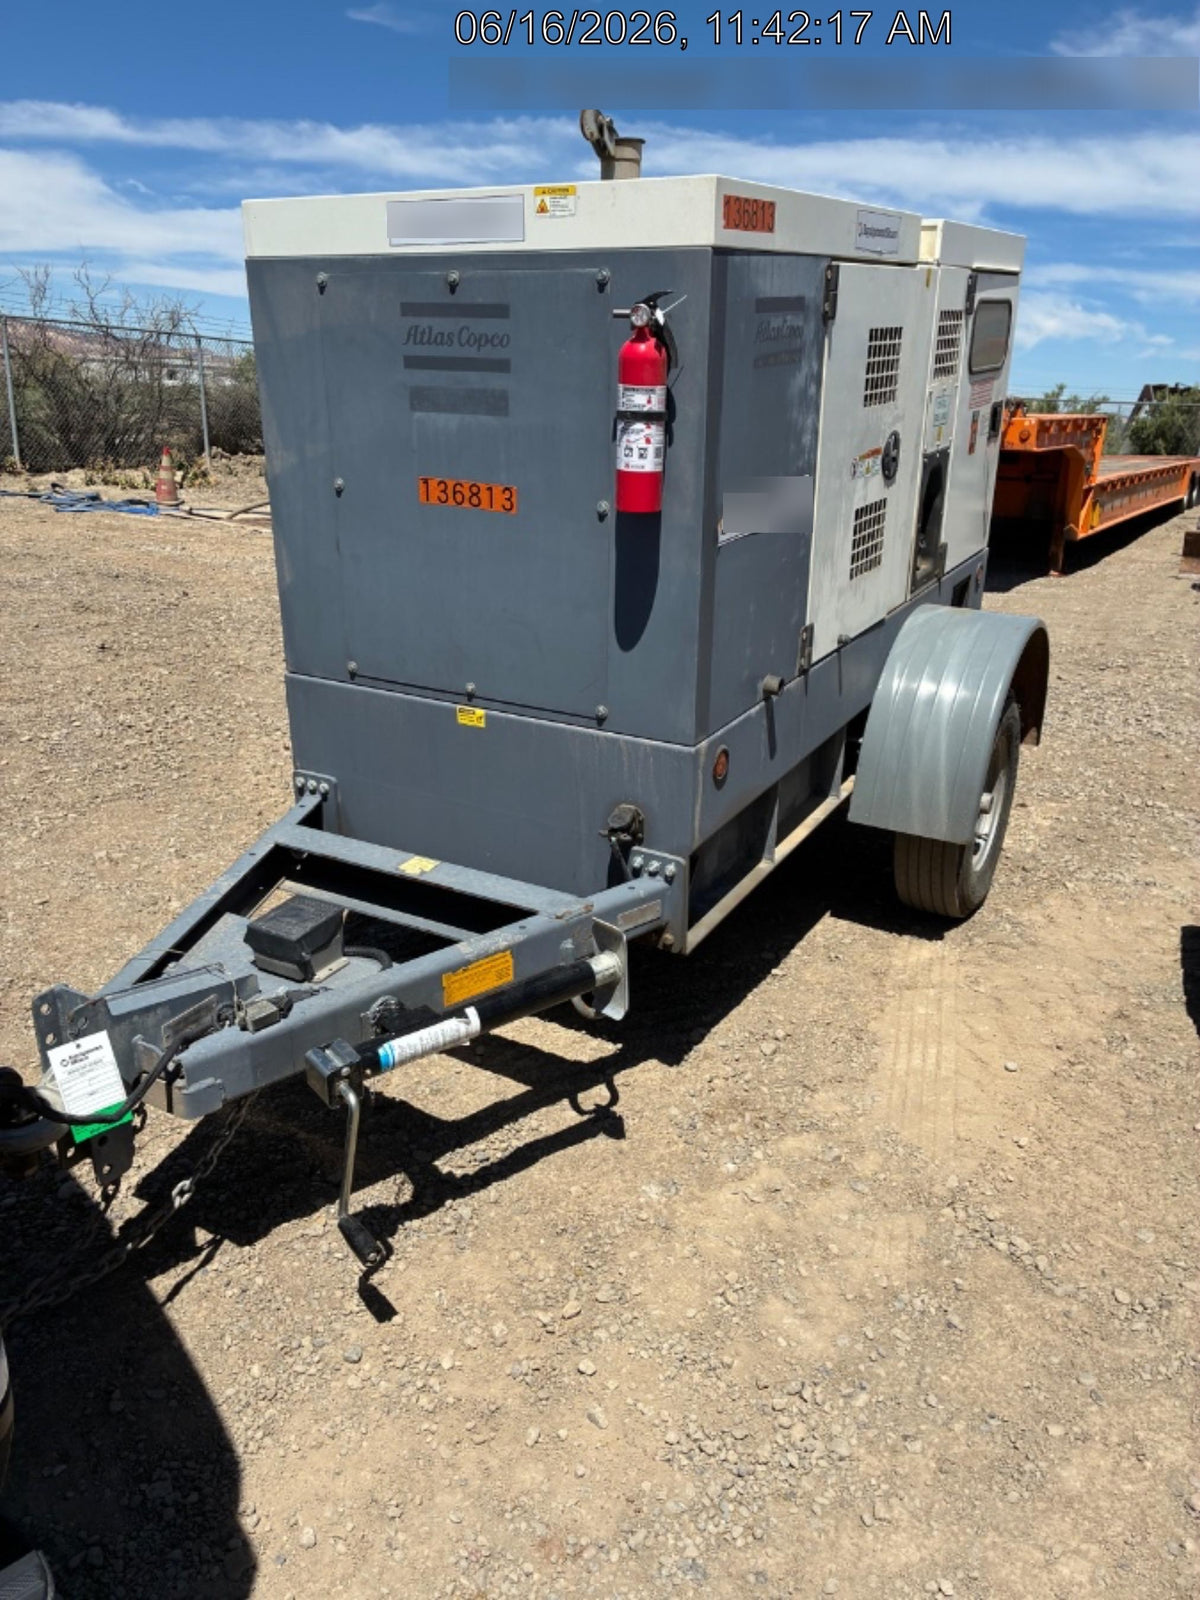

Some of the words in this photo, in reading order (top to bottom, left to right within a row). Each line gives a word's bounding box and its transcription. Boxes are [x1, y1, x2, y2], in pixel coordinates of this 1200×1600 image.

[724, 196, 775, 231] 136813
[404, 325, 454, 347] Atlas
[458, 325, 510, 352] Copco
[422, 478, 514, 512] 136813
